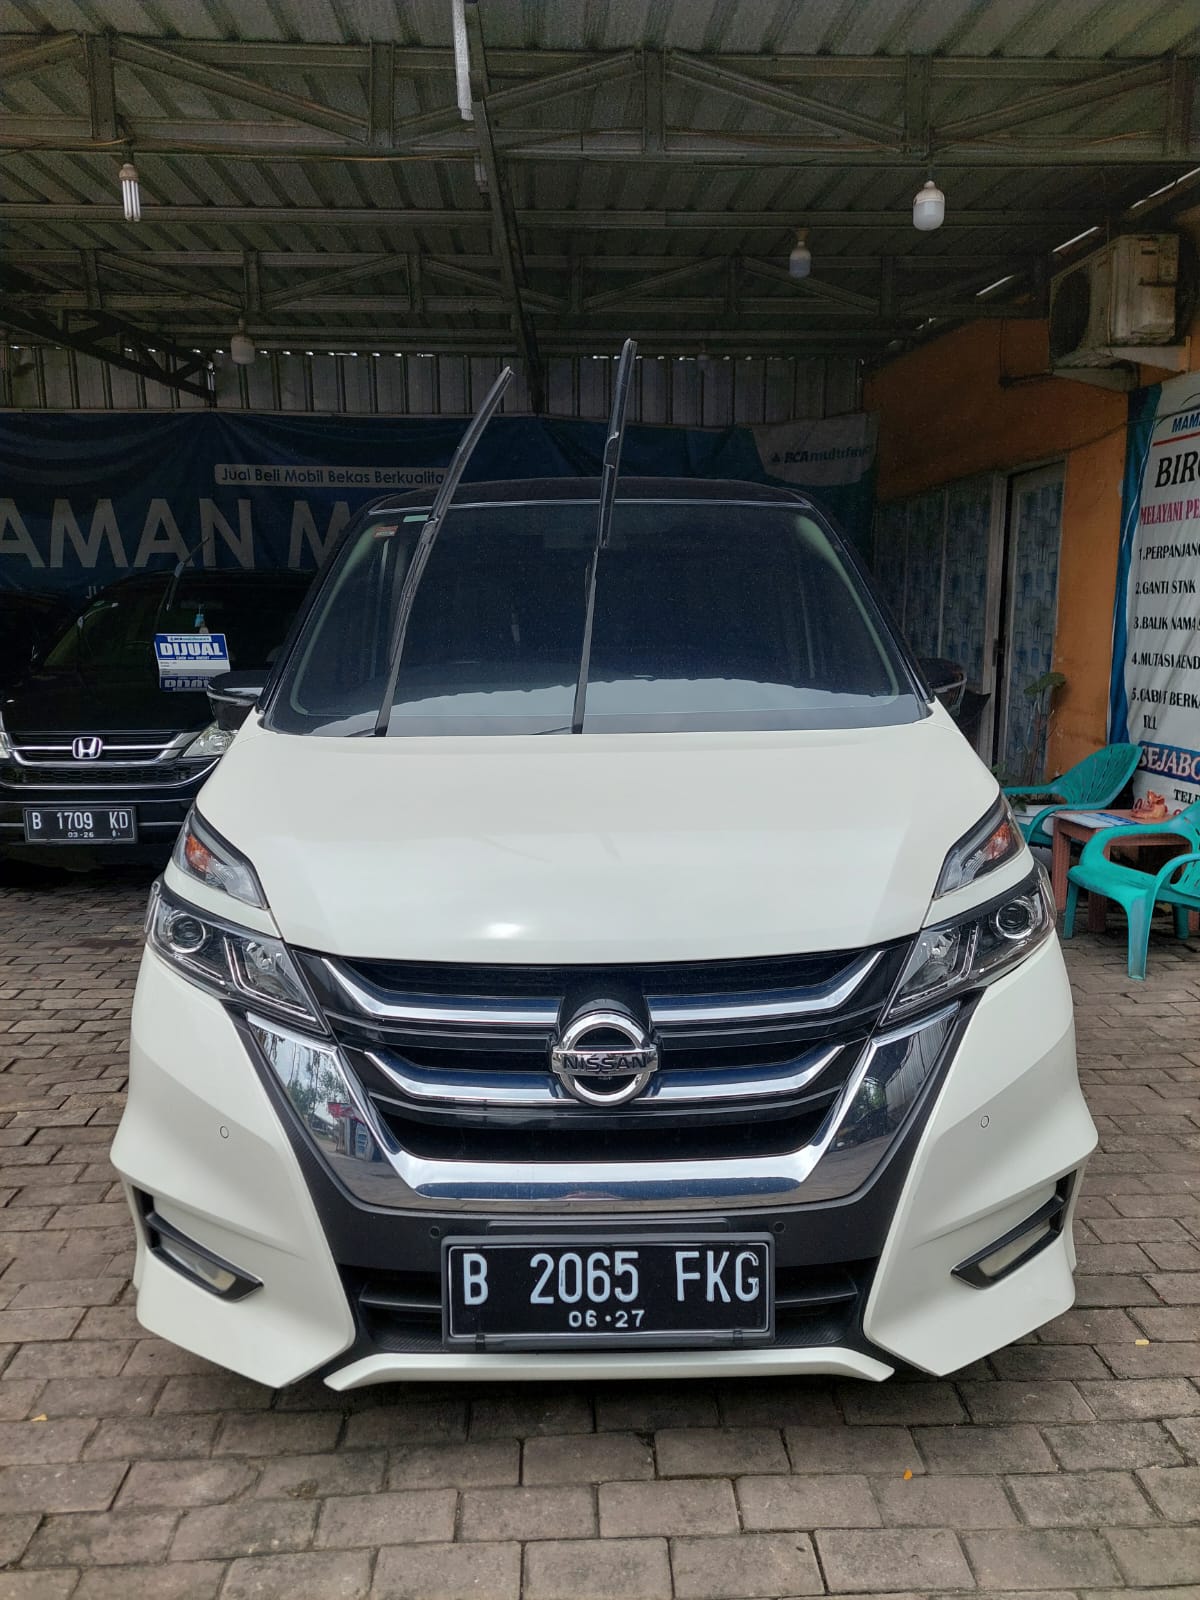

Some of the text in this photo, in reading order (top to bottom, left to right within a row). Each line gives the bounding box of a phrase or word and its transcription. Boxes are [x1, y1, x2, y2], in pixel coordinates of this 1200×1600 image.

[1172, 412, 1200, 433] MAM
[221, 468, 444, 485] Jual Beli Mobil Bekas Berkualita
[1155, 451, 1200, 488] BIR
[1140, 501, 1183, 526] MELAYANI
[1171, 579, 1196, 594] STNK
[1171, 616, 1196, 631] NAMA
[160, 642, 223, 656] DIJUAL
[1169, 691, 1200, 710] BERK
[31, 811, 129, 830] B 1709 KD
[563, 1055, 648, 1073] NISSAN
[462, 1250, 760, 1306] B 2065 FKG
